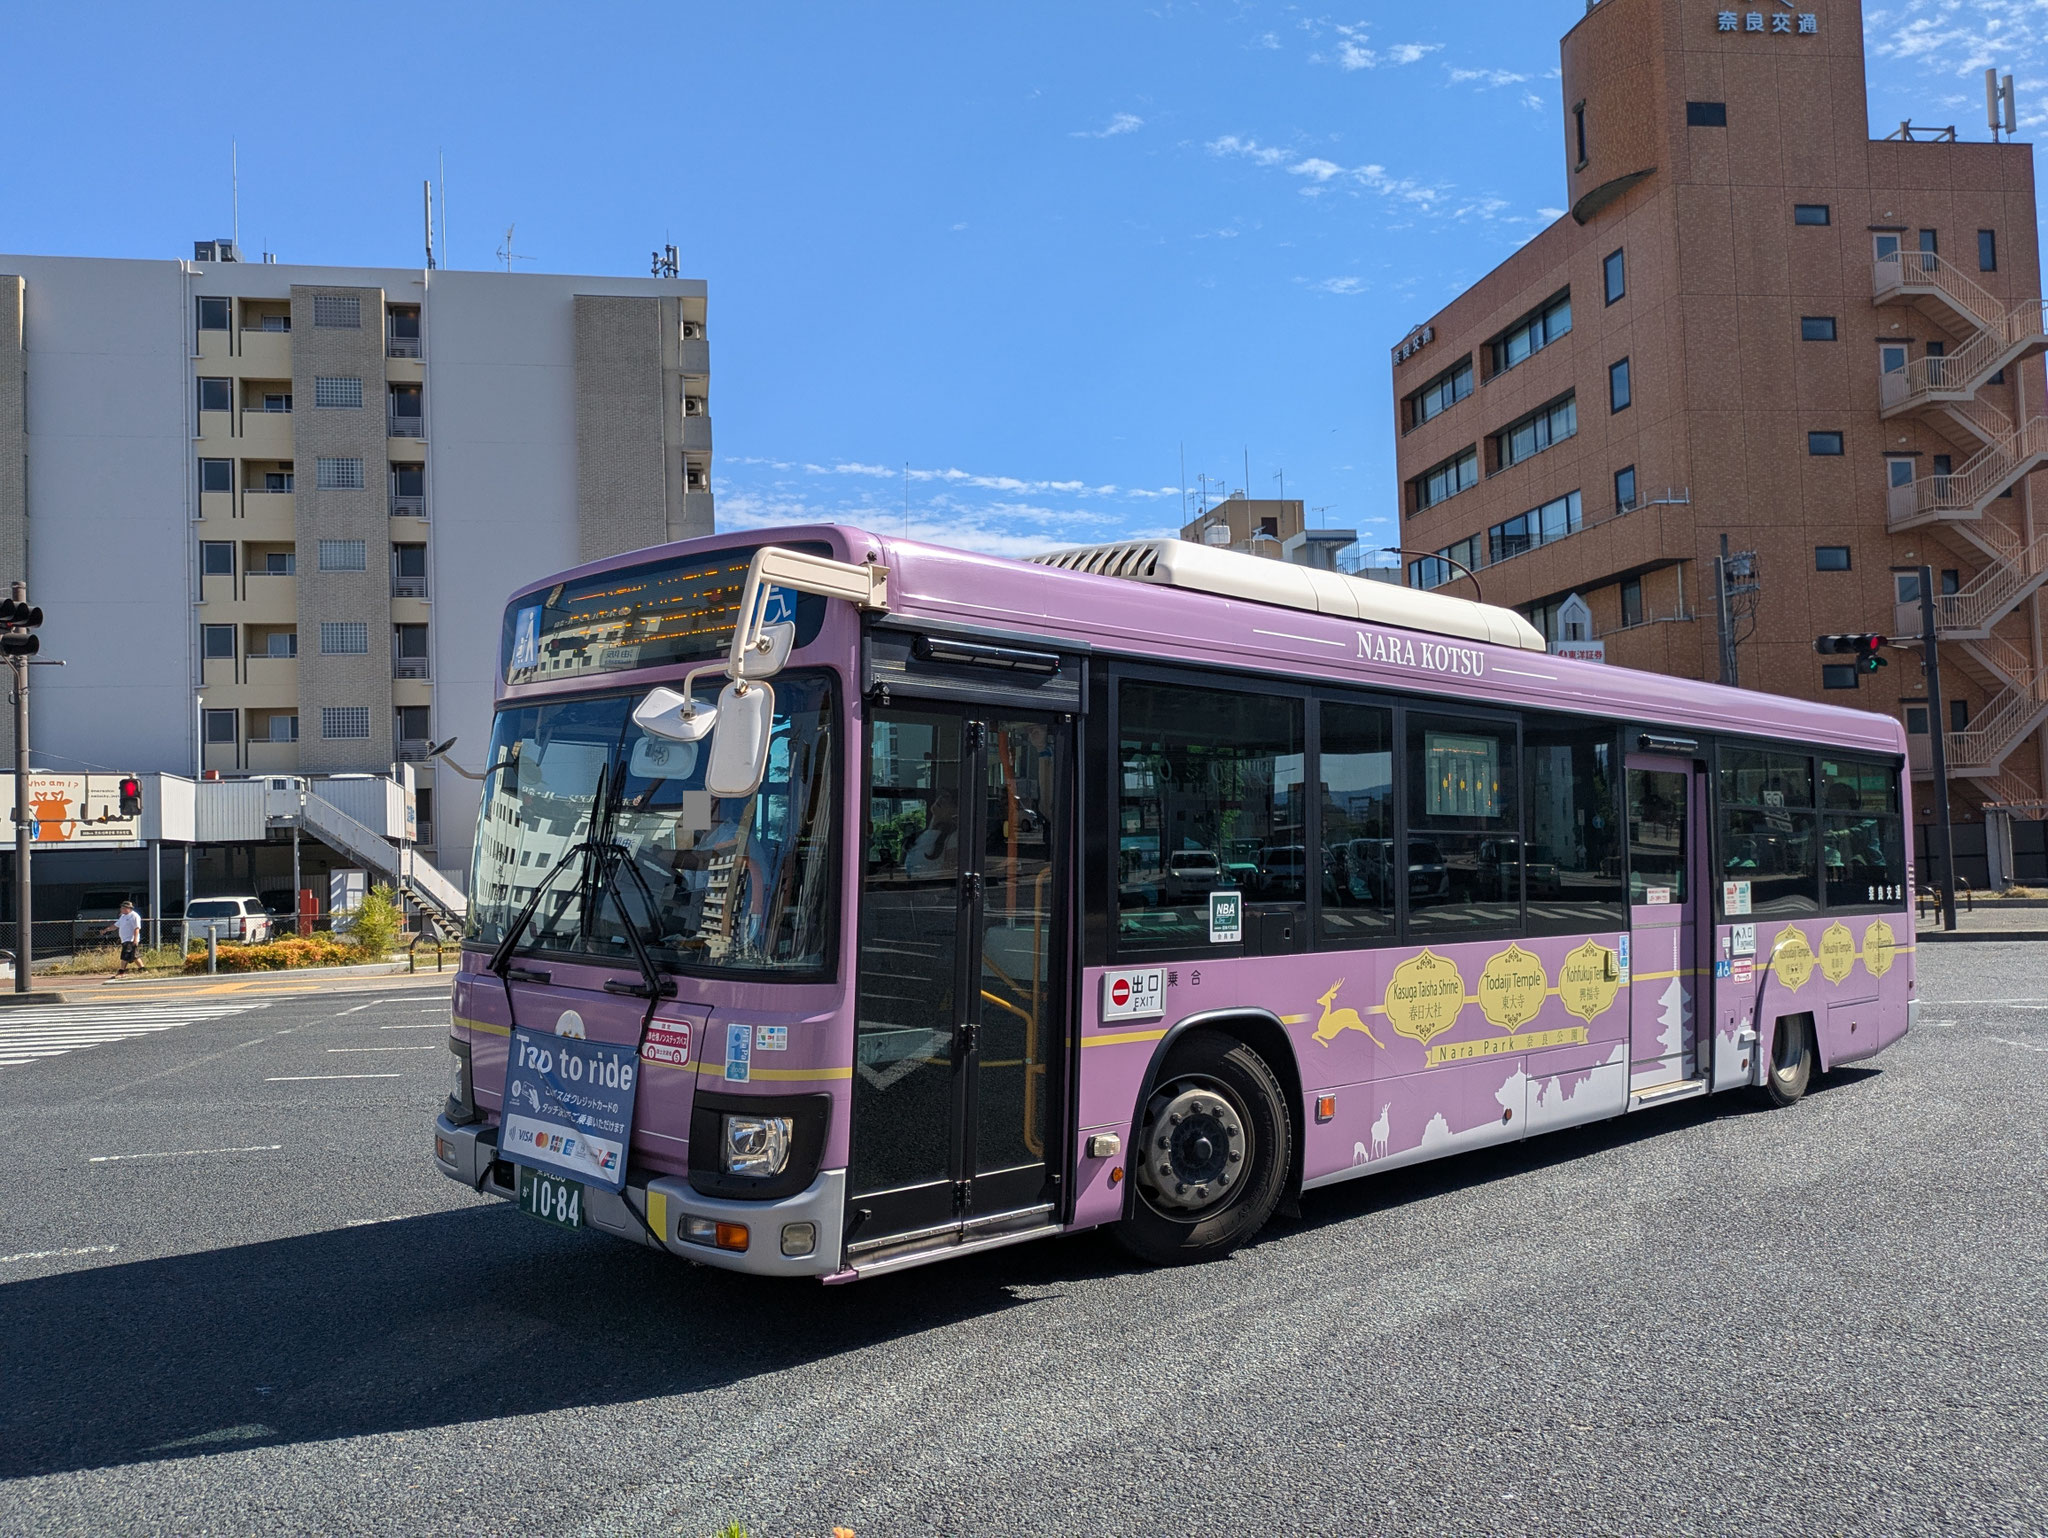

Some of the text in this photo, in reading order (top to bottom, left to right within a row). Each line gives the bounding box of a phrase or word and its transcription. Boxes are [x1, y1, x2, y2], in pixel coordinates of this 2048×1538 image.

[1718, 11, 1818, 34] 奈良交通
[1356, 630, 1485, 677] NARA KOTSU
[1868, 885, 1901, 900] 奈良交通
[1216, 903, 1235, 915] NBA
[1741, 927, 1752, 939] 入口
[1132, 974, 1159, 994] 出口
[1167, 970, 1201, 987] 乗合
[1485, 970, 1541, 993] Todaiji Temple
[1566, 965, 1592, 985] Kohfukuji
[1393, 979, 1459, 1003] Kasuga Taisha Shrine
[1134, 996, 1155, 1007] EXIT
[1408, 1002, 1442, 1021] 春日大社
[1502, 993, 1525, 1010] 東大寺
[741, 1028, 750, 1061] PiTaPa
[1526, 1029, 1578, 1047] 奈良公園
[1439, 1037, 1514, 1061] Nara Park
[516, 1033, 633, 1091] Tap to ride
[519, 1128, 534, 1143] VISA
[532, 1177, 579, 1227] 10-84
